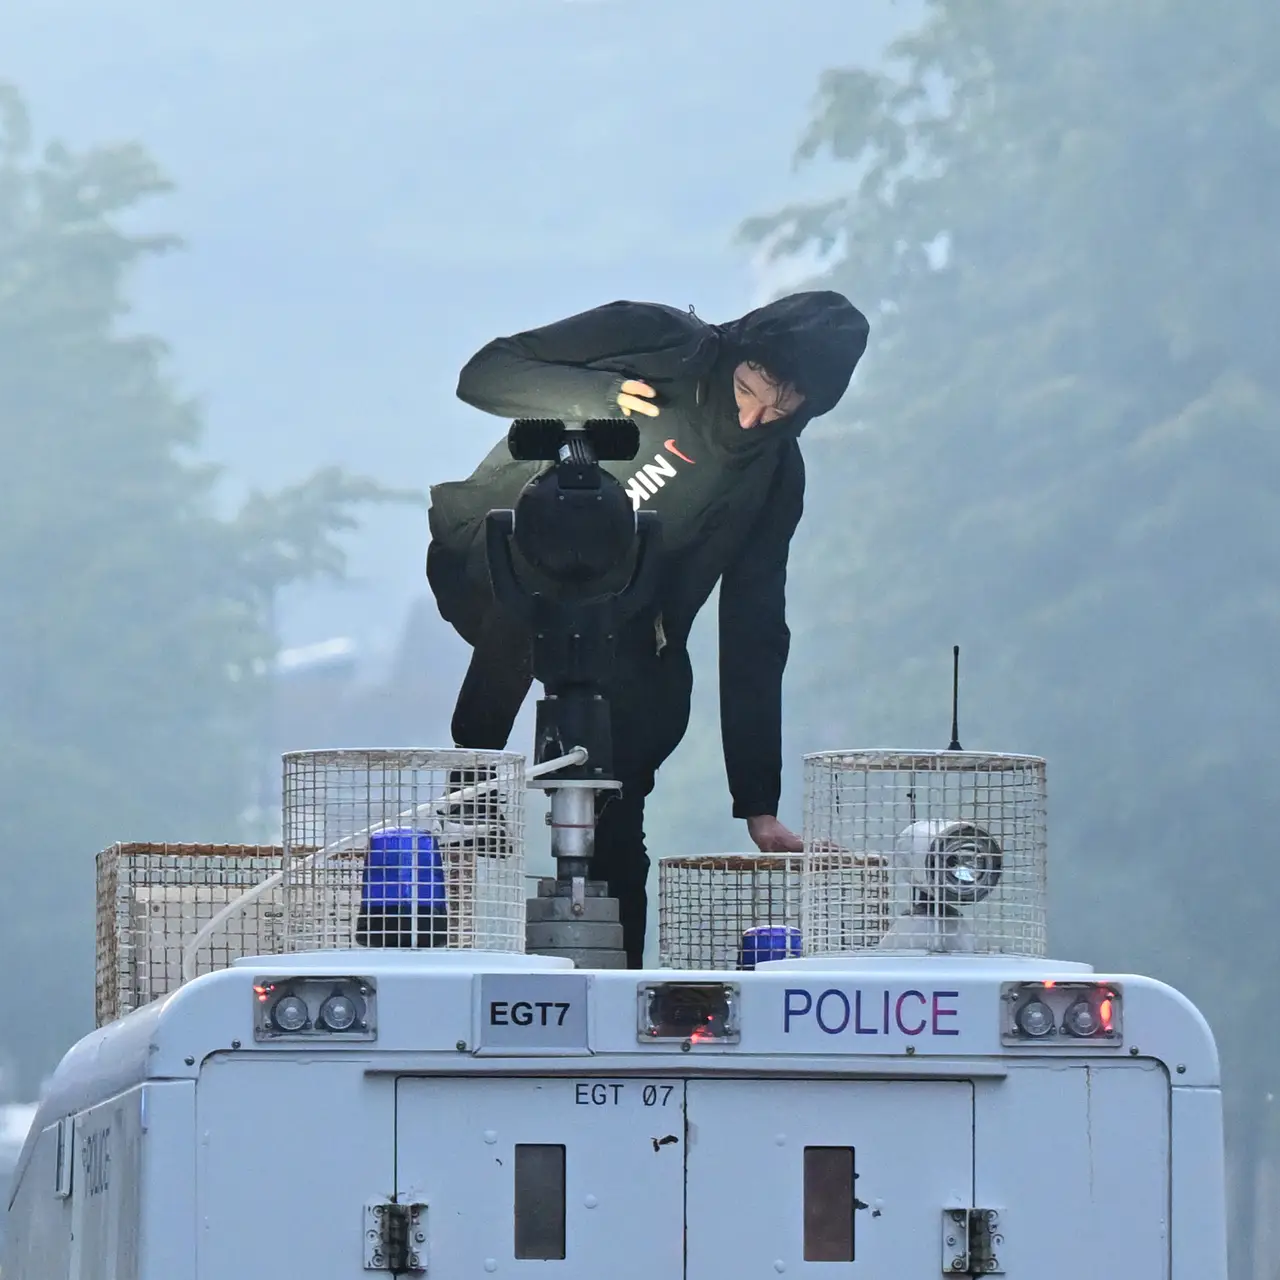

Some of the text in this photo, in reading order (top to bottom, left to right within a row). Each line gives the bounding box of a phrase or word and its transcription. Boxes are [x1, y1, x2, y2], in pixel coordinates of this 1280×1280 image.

[625, 453, 678, 512] NIK
[490, 1001, 571, 1027] EGT7
[783, 988, 960, 1036] POLICE
[574, 1082, 625, 1106] EGT
